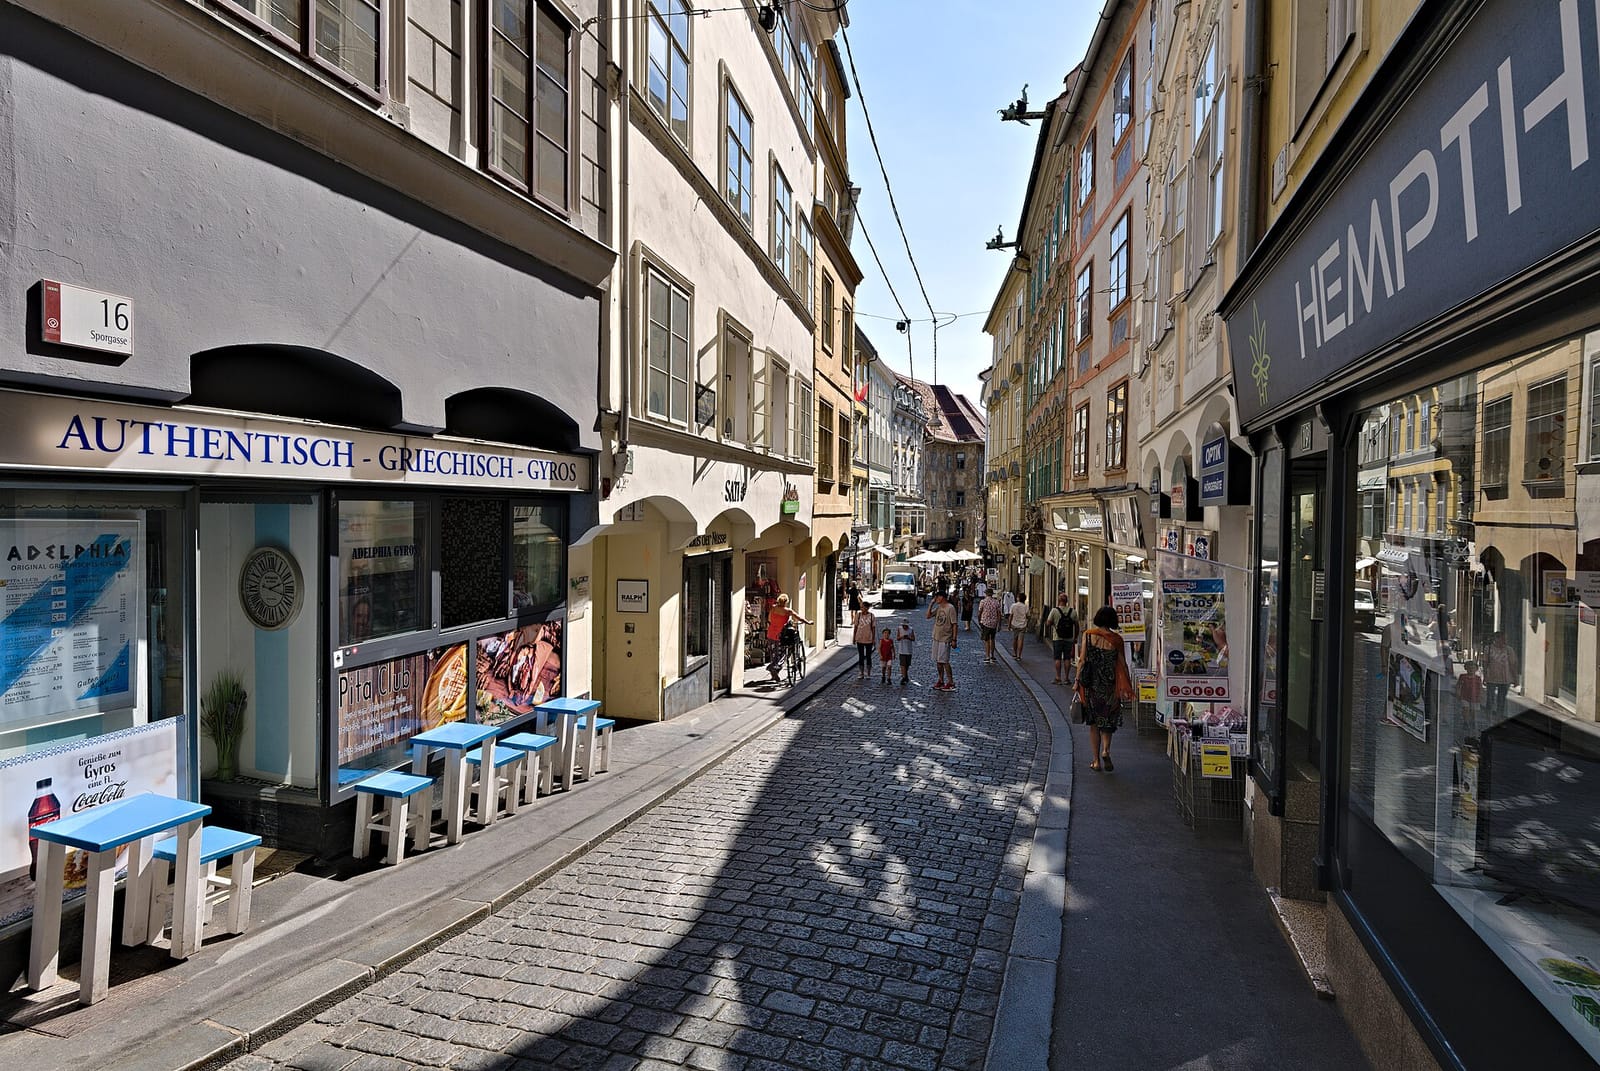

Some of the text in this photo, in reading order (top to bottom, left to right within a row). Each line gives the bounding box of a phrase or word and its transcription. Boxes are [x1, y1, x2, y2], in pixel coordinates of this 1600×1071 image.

[1295, 0, 1600, 360] HEMPTH
[100, 299, 129, 331] 16
[90, 329, 128, 346] Sporgasse
[56, 414, 355, 468] AUTHENTISCH
[378, 445, 514, 479] GRIECHISCH
[527, 459, 577, 482] GYROS
[1205, 442, 1222, 465] OPTIK
[6, 543, 126, 562] ADELPHIA
[352, 546, 392, 560] ADELPHIA
[11, 563, 47, 571] ORIGINAL
[1175, 597, 1213, 608] Fotos
[339, 659, 411, 708] Pita Club
[78, 750, 121, 767] Genieße zum
[84, 762, 116, 781] Gyros
[87, 780, 102, 789] eine
